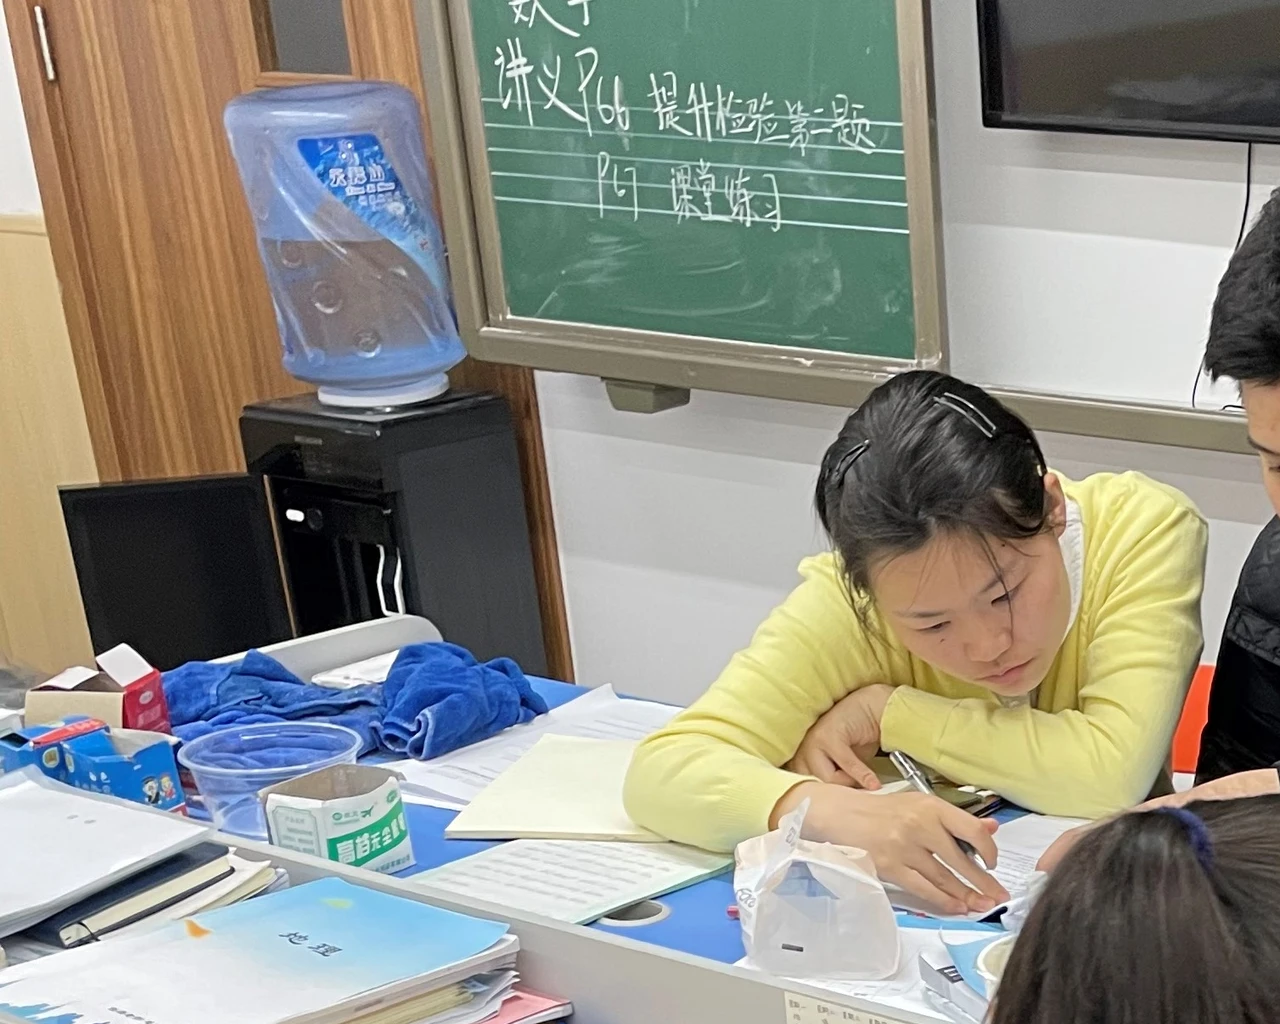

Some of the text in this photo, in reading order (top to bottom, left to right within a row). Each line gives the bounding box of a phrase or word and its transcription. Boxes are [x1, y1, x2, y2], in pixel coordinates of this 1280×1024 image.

[670, 158, 781, 232] 课堂练习
[278, 931, 343, 957] 地理
